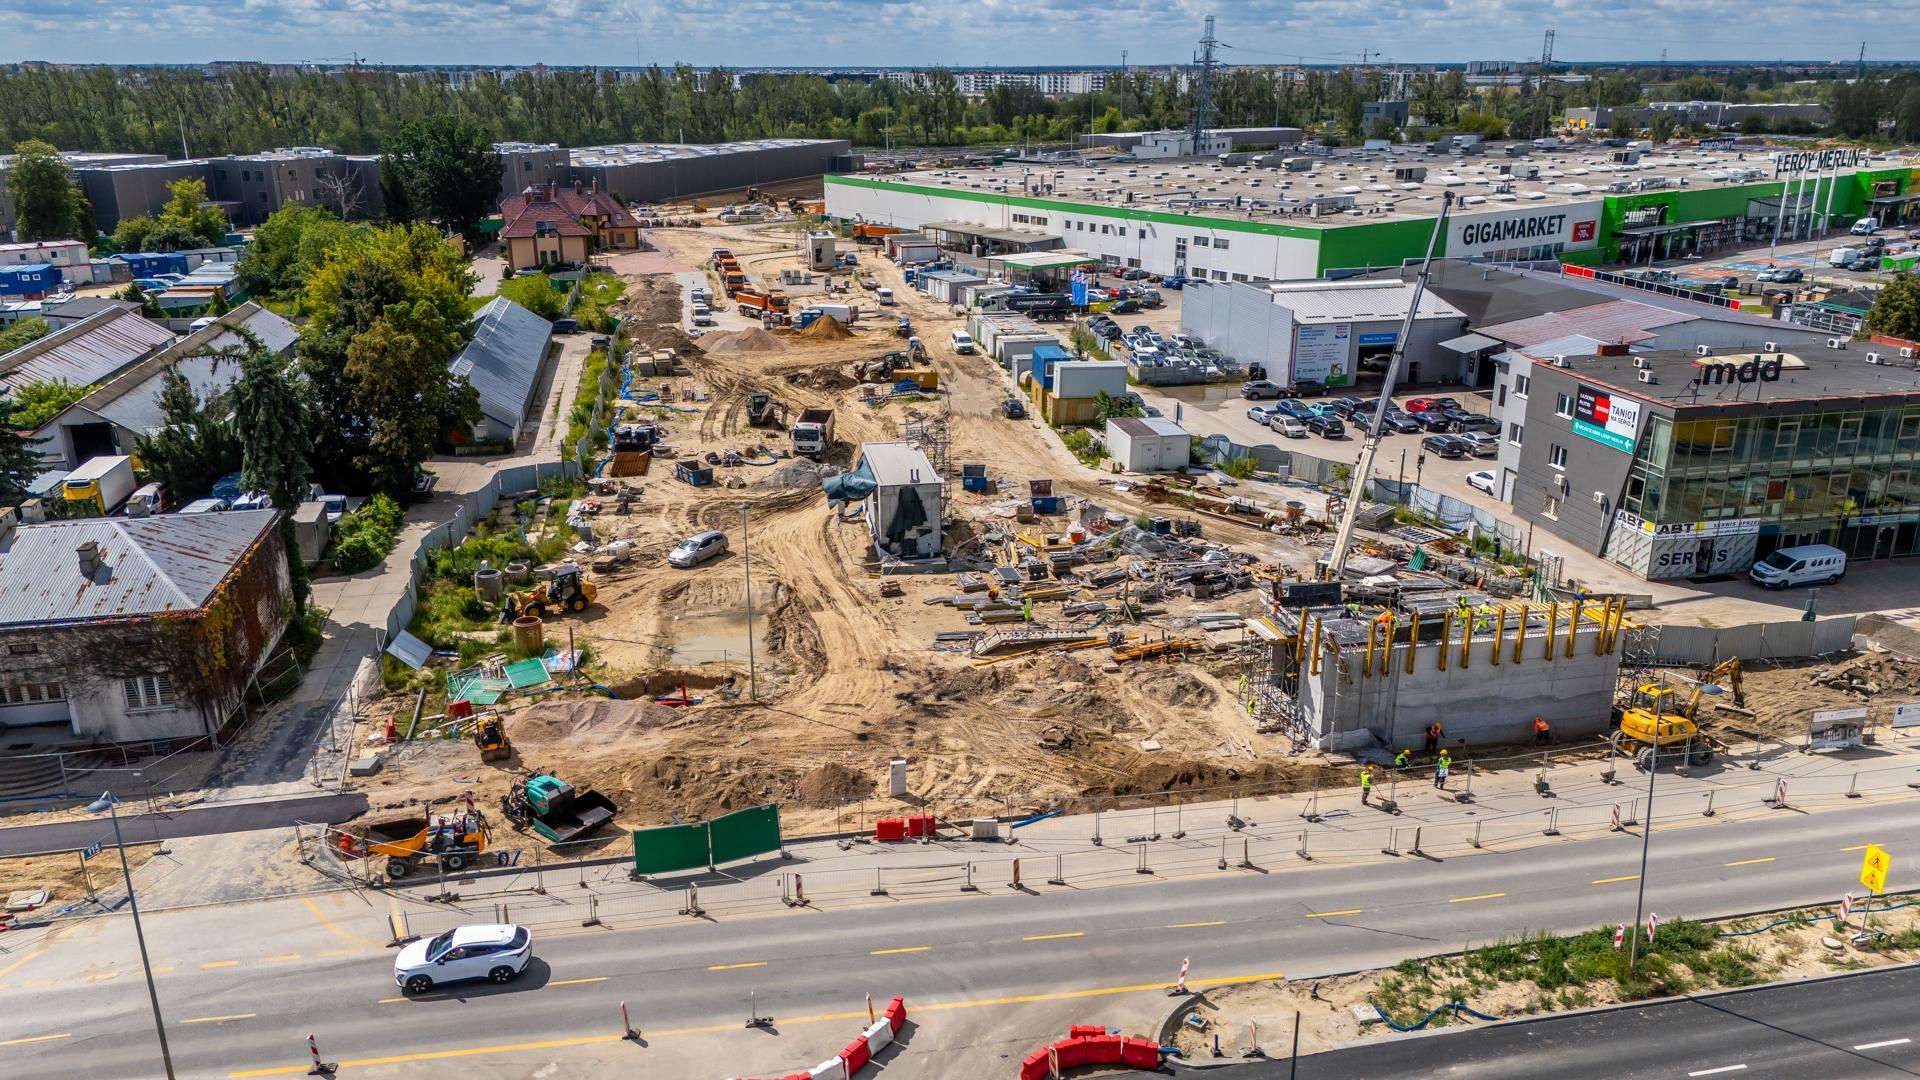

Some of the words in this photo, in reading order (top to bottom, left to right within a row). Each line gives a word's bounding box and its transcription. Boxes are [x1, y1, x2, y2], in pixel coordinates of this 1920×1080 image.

[1776, 151, 1815, 173] LEROY
[1817, 148, 1861, 170] MERLIN
[1463, 214, 1566, 245] GIGAMARKET
[1703, 354, 1784, 385] mdd
[1617, 417, 1631, 427] SERIO
[1618, 511, 1645, 529] ABT
[1657, 523, 1694, 535] ABT
